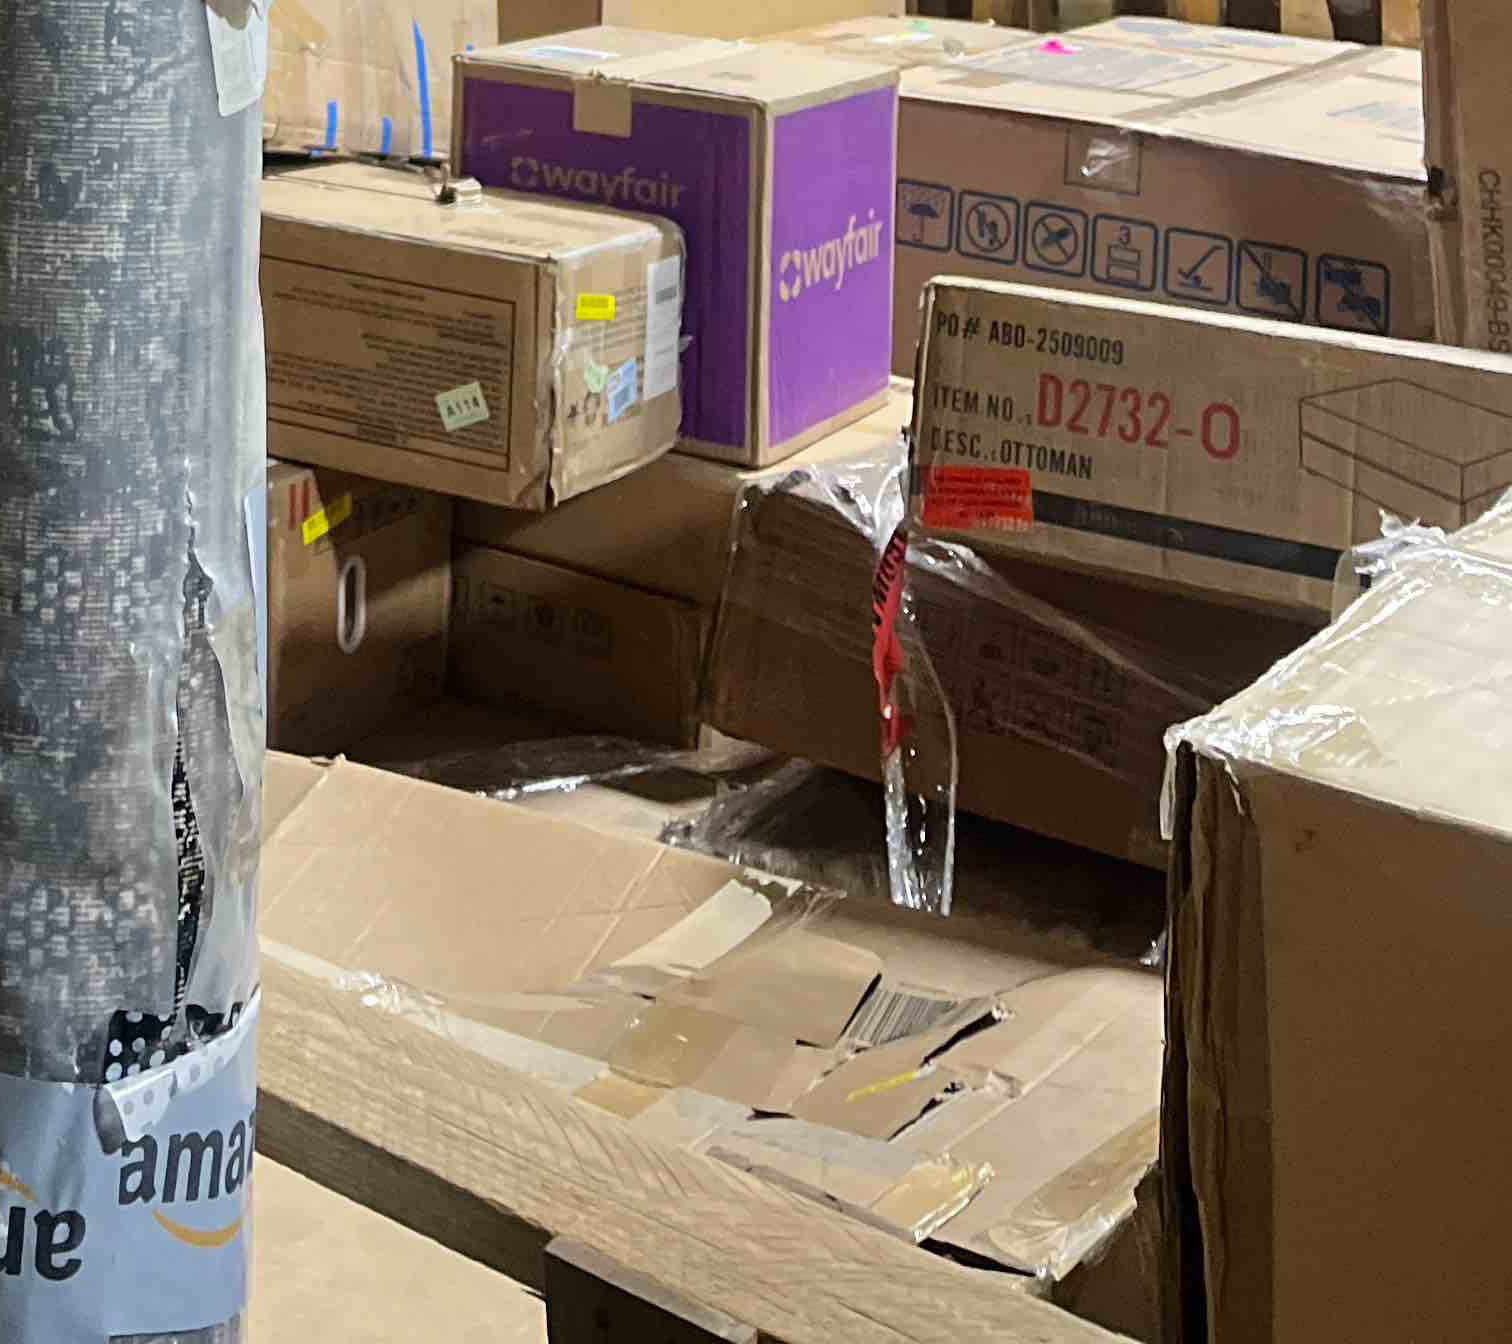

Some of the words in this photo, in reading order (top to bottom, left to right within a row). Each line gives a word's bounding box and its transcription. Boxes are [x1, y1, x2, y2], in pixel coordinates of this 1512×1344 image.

[541, 162, 688, 209] wayfair
[803, 207, 884, 293] wayfair
[1119, 226, 1131, 245] 3
[931, 383, 979, 413] ITEM
